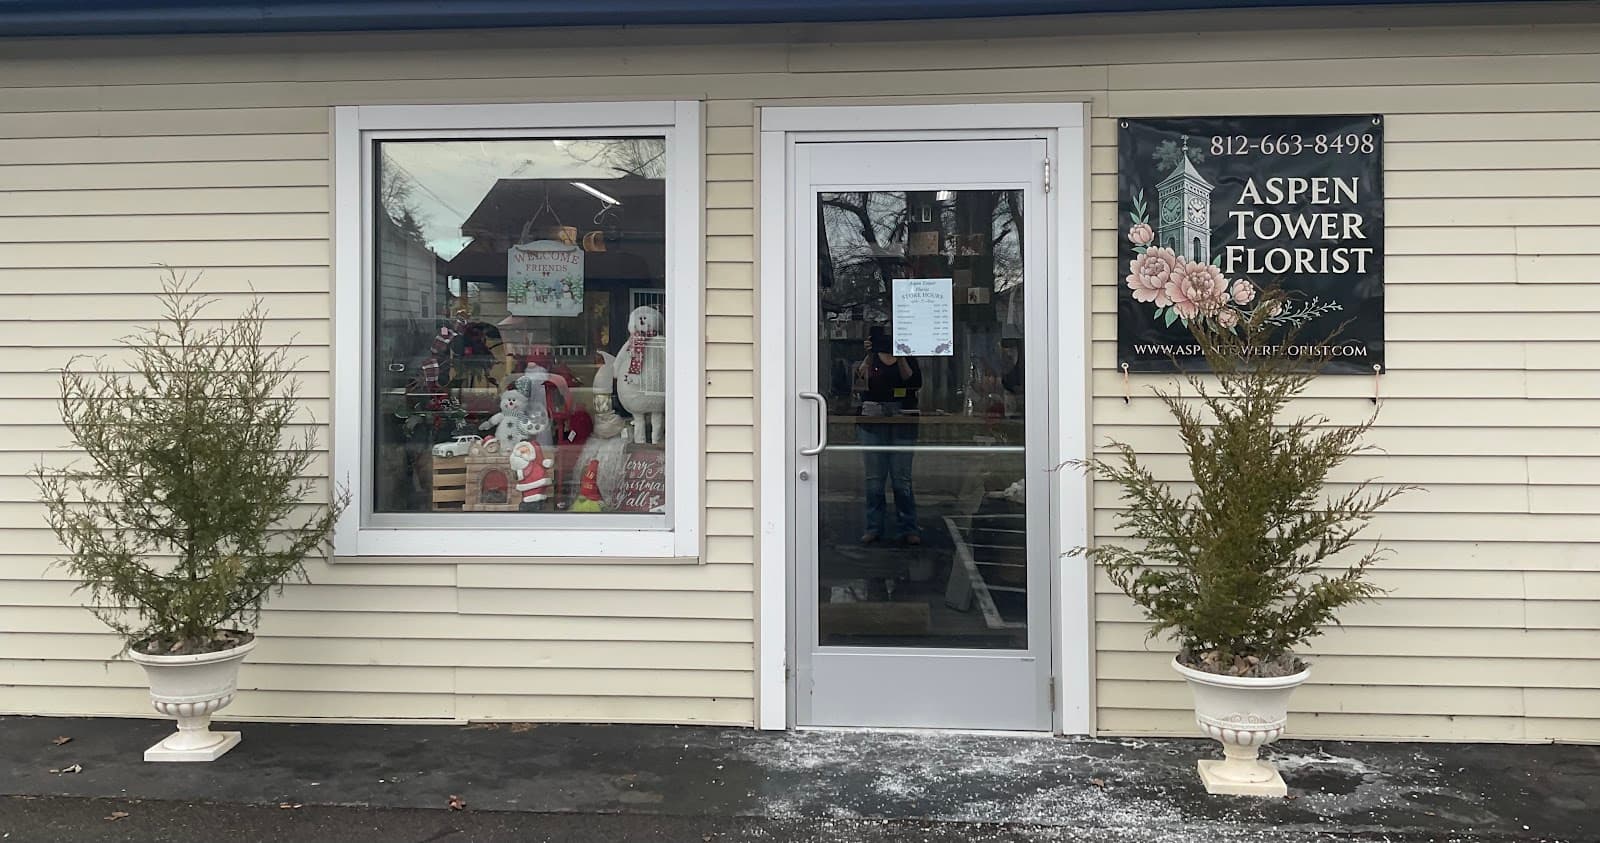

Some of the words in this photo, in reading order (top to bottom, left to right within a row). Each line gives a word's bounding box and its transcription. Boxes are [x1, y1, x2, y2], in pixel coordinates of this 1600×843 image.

[1210, 134, 1374, 155] 812-663-8498
[1237, 177, 1359, 205] ASPEN
[1228, 211, 1367, 240] TOWER
[514, 250, 579, 265] WELCOME
[526, 264, 568, 272] FRIENDS
[1225, 246, 1373, 274] FLORIST
